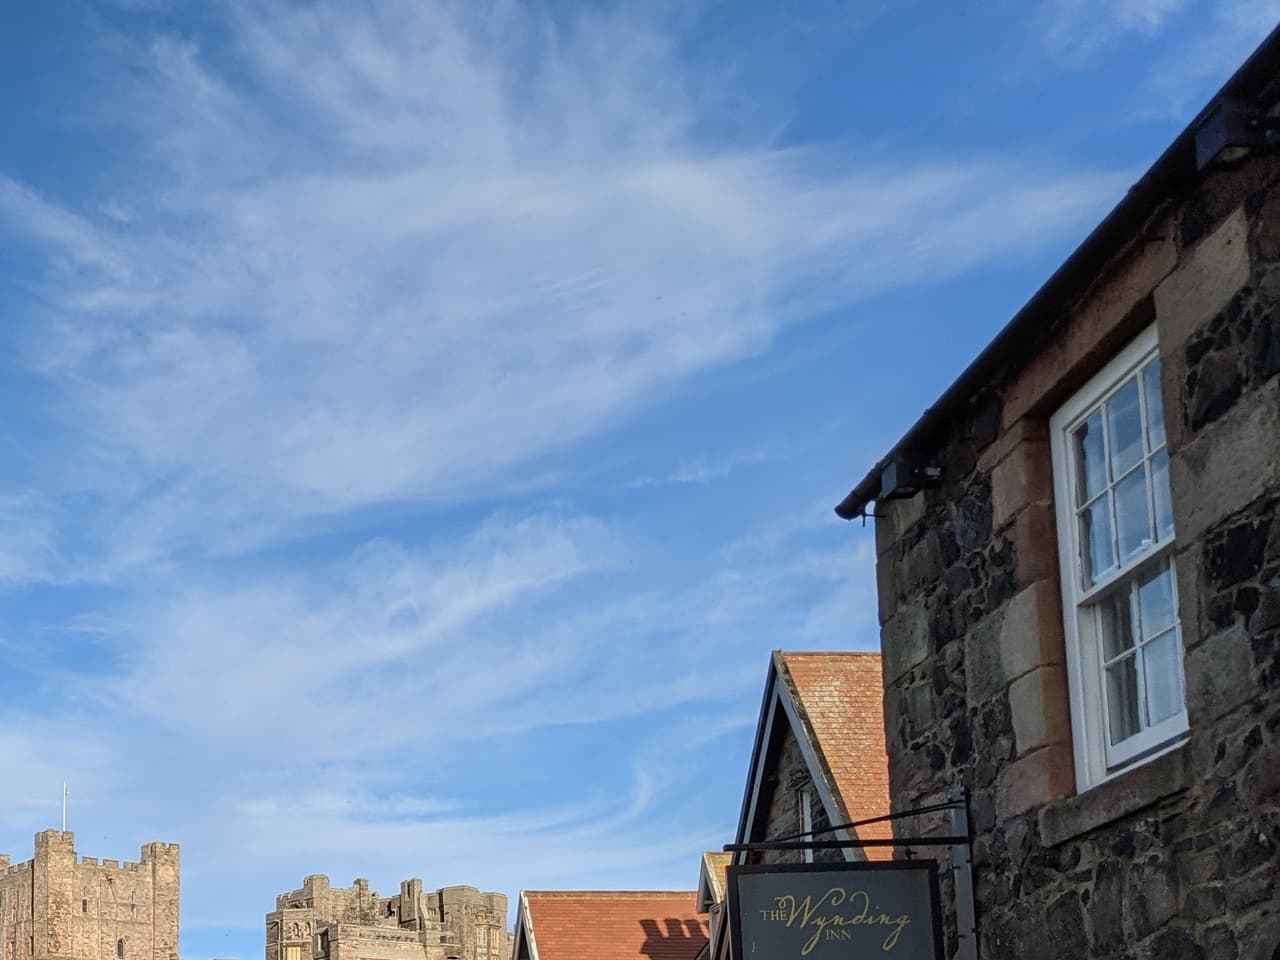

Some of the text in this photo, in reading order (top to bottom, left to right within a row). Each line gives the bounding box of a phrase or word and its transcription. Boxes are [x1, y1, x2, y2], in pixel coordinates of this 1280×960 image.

[760, 887, 911, 956] THE Wynding
[825, 929, 851, 941] INN
